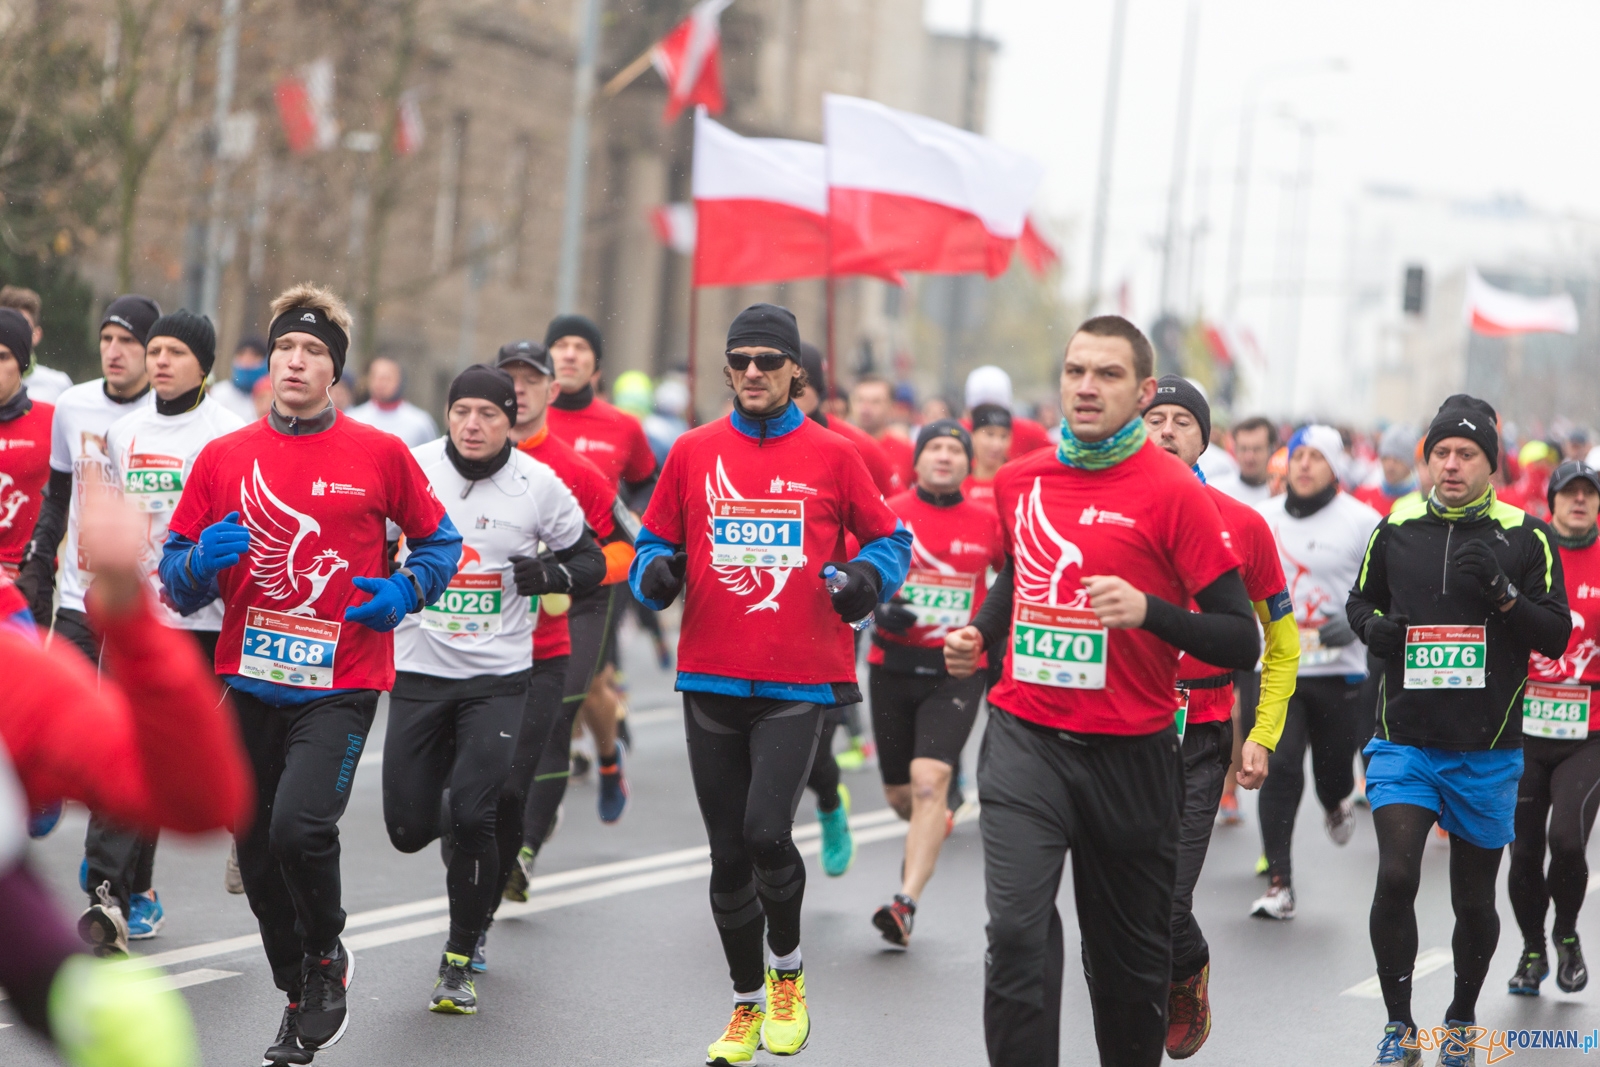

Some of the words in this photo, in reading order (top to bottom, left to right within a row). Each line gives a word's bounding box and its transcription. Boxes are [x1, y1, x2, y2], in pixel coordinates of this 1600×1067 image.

[129, 471, 175, 492] 9438
[716, 528, 723, 536] E
[724, 521, 790, 544] 6901
[912, 587, 966, 610] 2732
[295, 624, 333, 637] RunPoland.org
[246, 637, 253, 646] E
[254, 633, 325, 665] 2168
[1023, 628, 1094, 661] 1470
[273, 662, 297, 672] Mateusz
[1415, 646, 1477, 667] 8076
[1529, 700, 1581, 721] 9548
